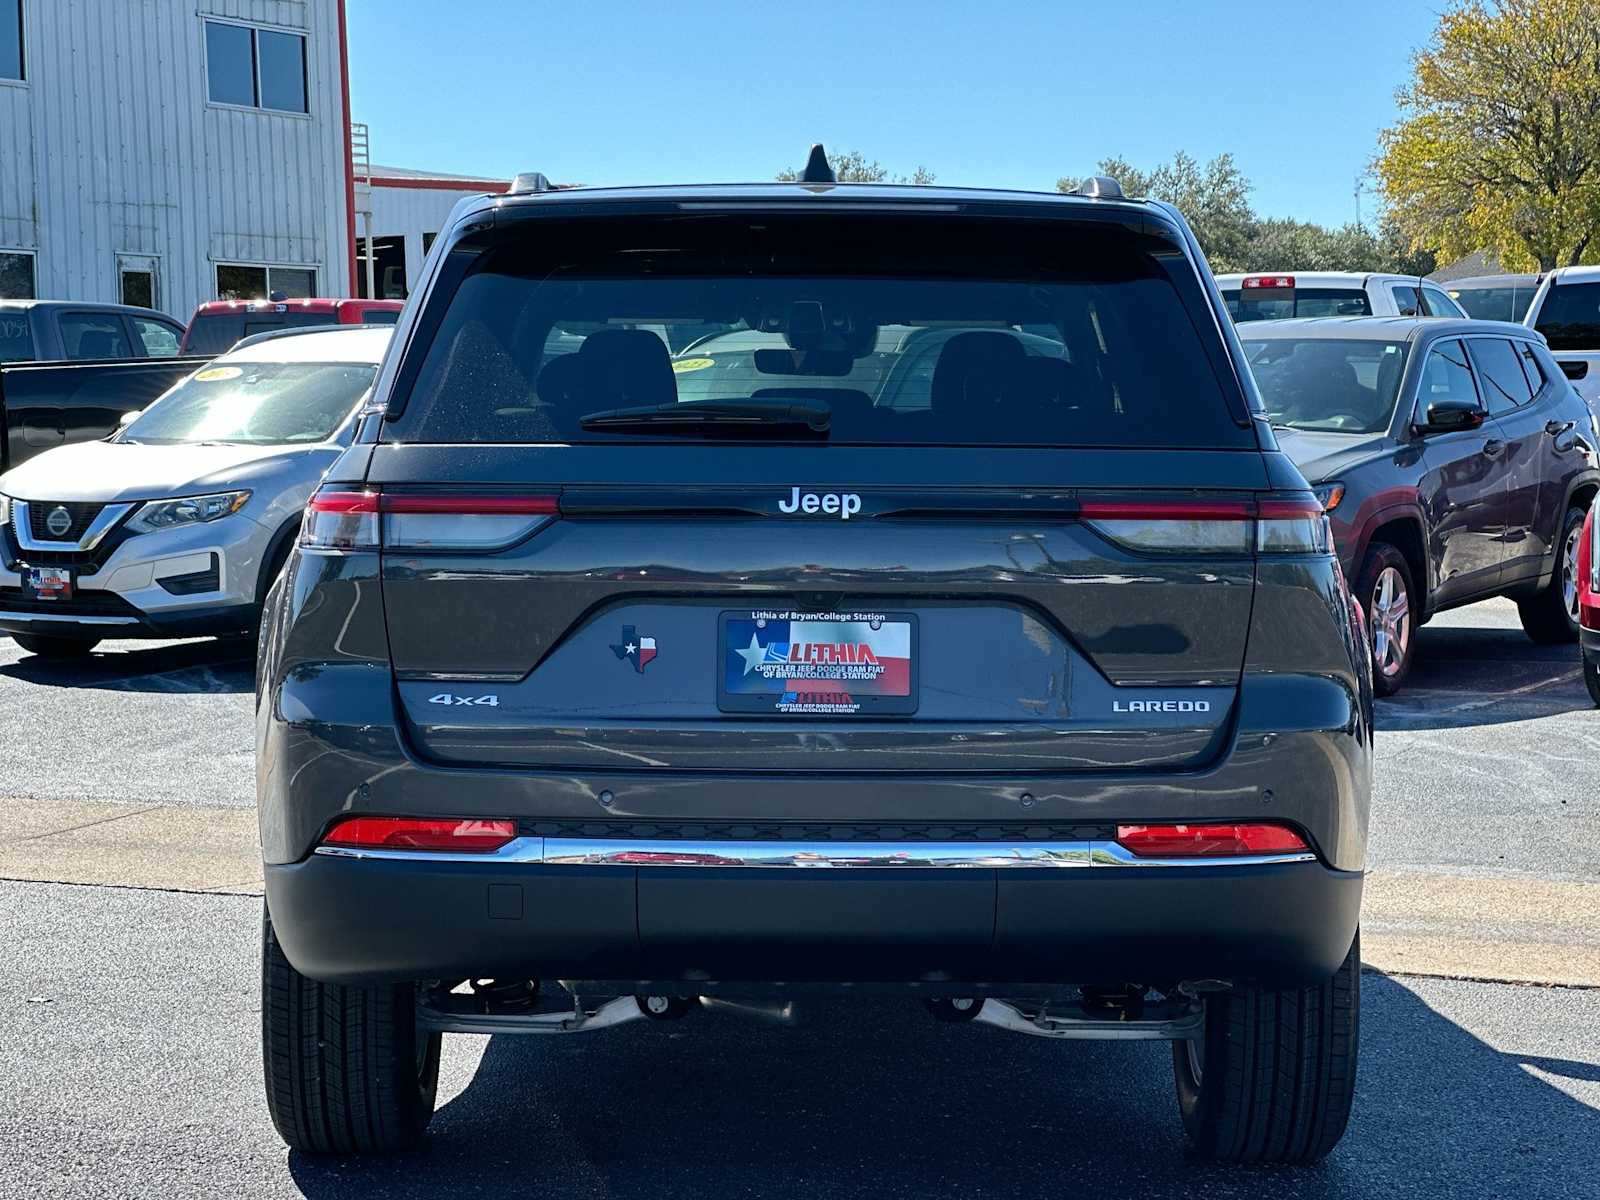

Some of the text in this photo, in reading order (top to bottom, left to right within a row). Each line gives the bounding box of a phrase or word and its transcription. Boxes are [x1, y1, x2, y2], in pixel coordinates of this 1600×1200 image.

[778, 487, 861, 519] Jeep
[751, 611, 886, 621] Lithia of Bryan/College Station
[789, 642, 879, 664] LITHIA
[754, 664, 886, 674] CHRYSLER JEEP DODGE RAM FIAT
[763, 671, 877, 680] OF BRYAN/COLLEGE STATION
[428, 693, 499, 706] 4x4
[1113, 700, 1210, 712] LAREDO
